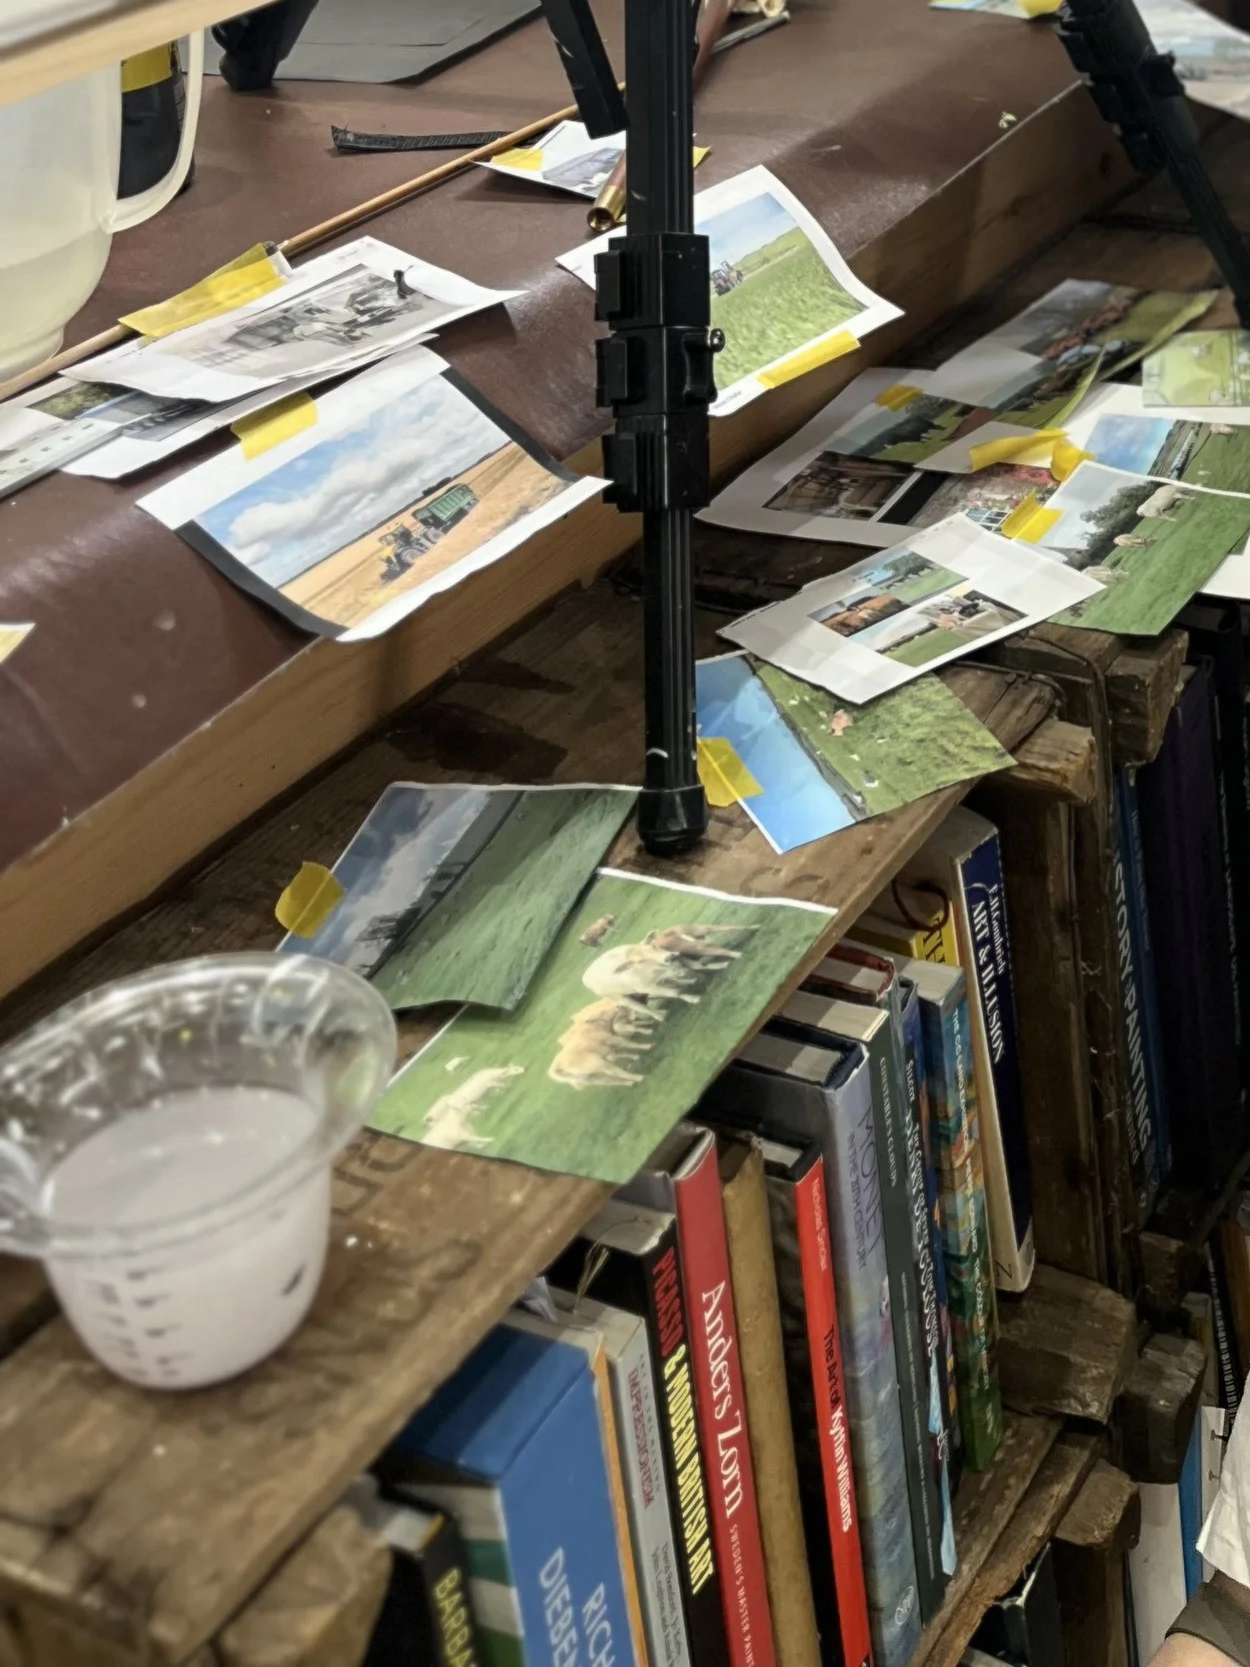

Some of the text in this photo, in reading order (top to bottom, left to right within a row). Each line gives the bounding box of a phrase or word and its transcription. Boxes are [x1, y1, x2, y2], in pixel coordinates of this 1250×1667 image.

[971, 899, 1007, 1064] ART & ILLUSION
[1124, 982, 1151, 1152] PAINTING
[857, 1104, 884, 1256] MONET
[887, 1136, 898, 1188] CLOUDS
[823, 1323, 835, 1364] The
[827, 1360, 838, 1392] Art
[652, 1245, 714, 1596] PICASSO & MODERN BRITISH ART
[701, 1280, 744, 1520] Anders Zorn
[836, 1453, 853, 1533] Williams
[434, 1565, 477, 1667] BARBA
[729, 1523, 744, 1585] SWEDEN'S
[737, 1585, 751, 1634] MASTER
